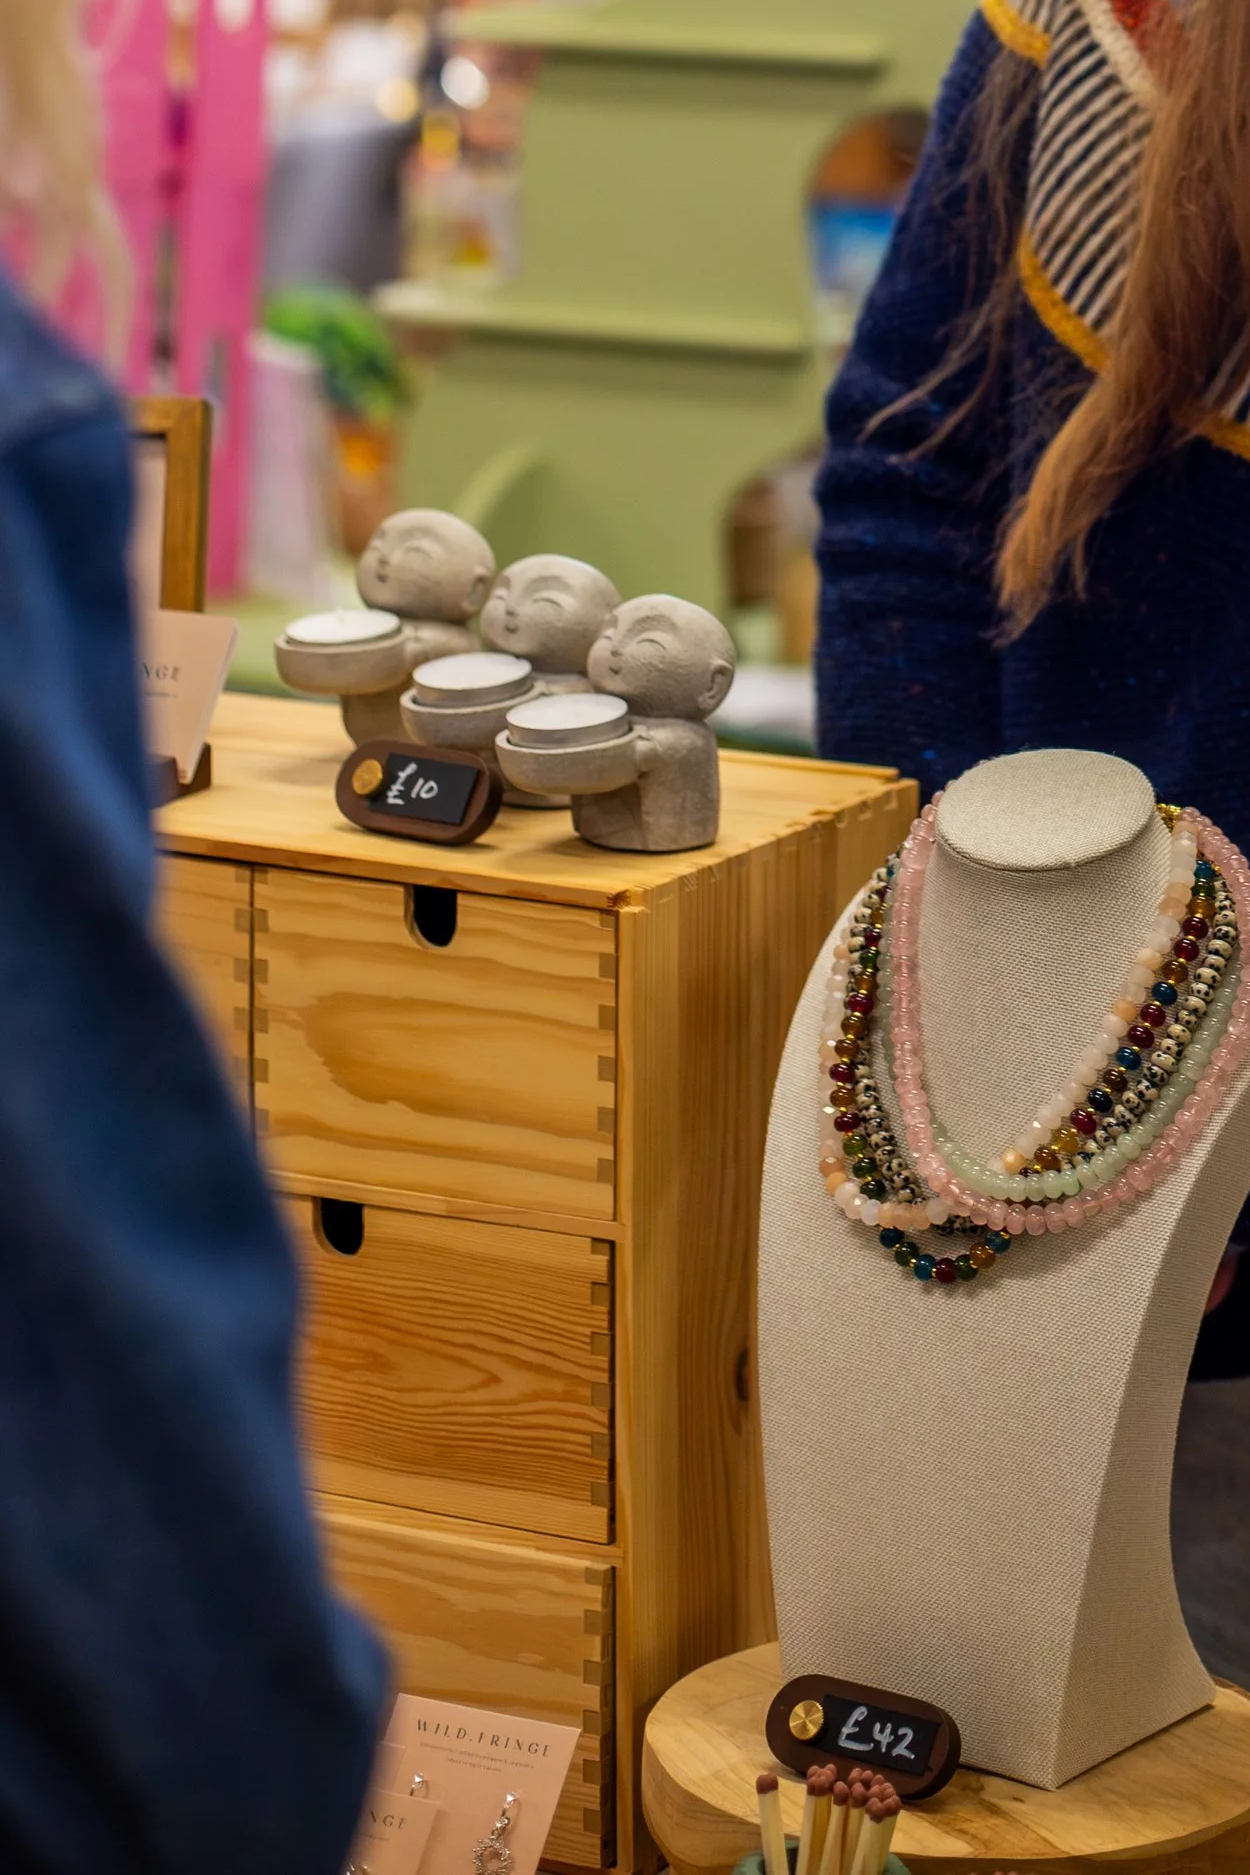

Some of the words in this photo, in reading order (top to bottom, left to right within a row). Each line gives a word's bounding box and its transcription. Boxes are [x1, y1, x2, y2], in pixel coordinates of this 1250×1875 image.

[386, 762, 438, 805] £10
[417, 1719, 552, 1757] WILD.FRINGE
[838, 1705, 915, 1759] £42
